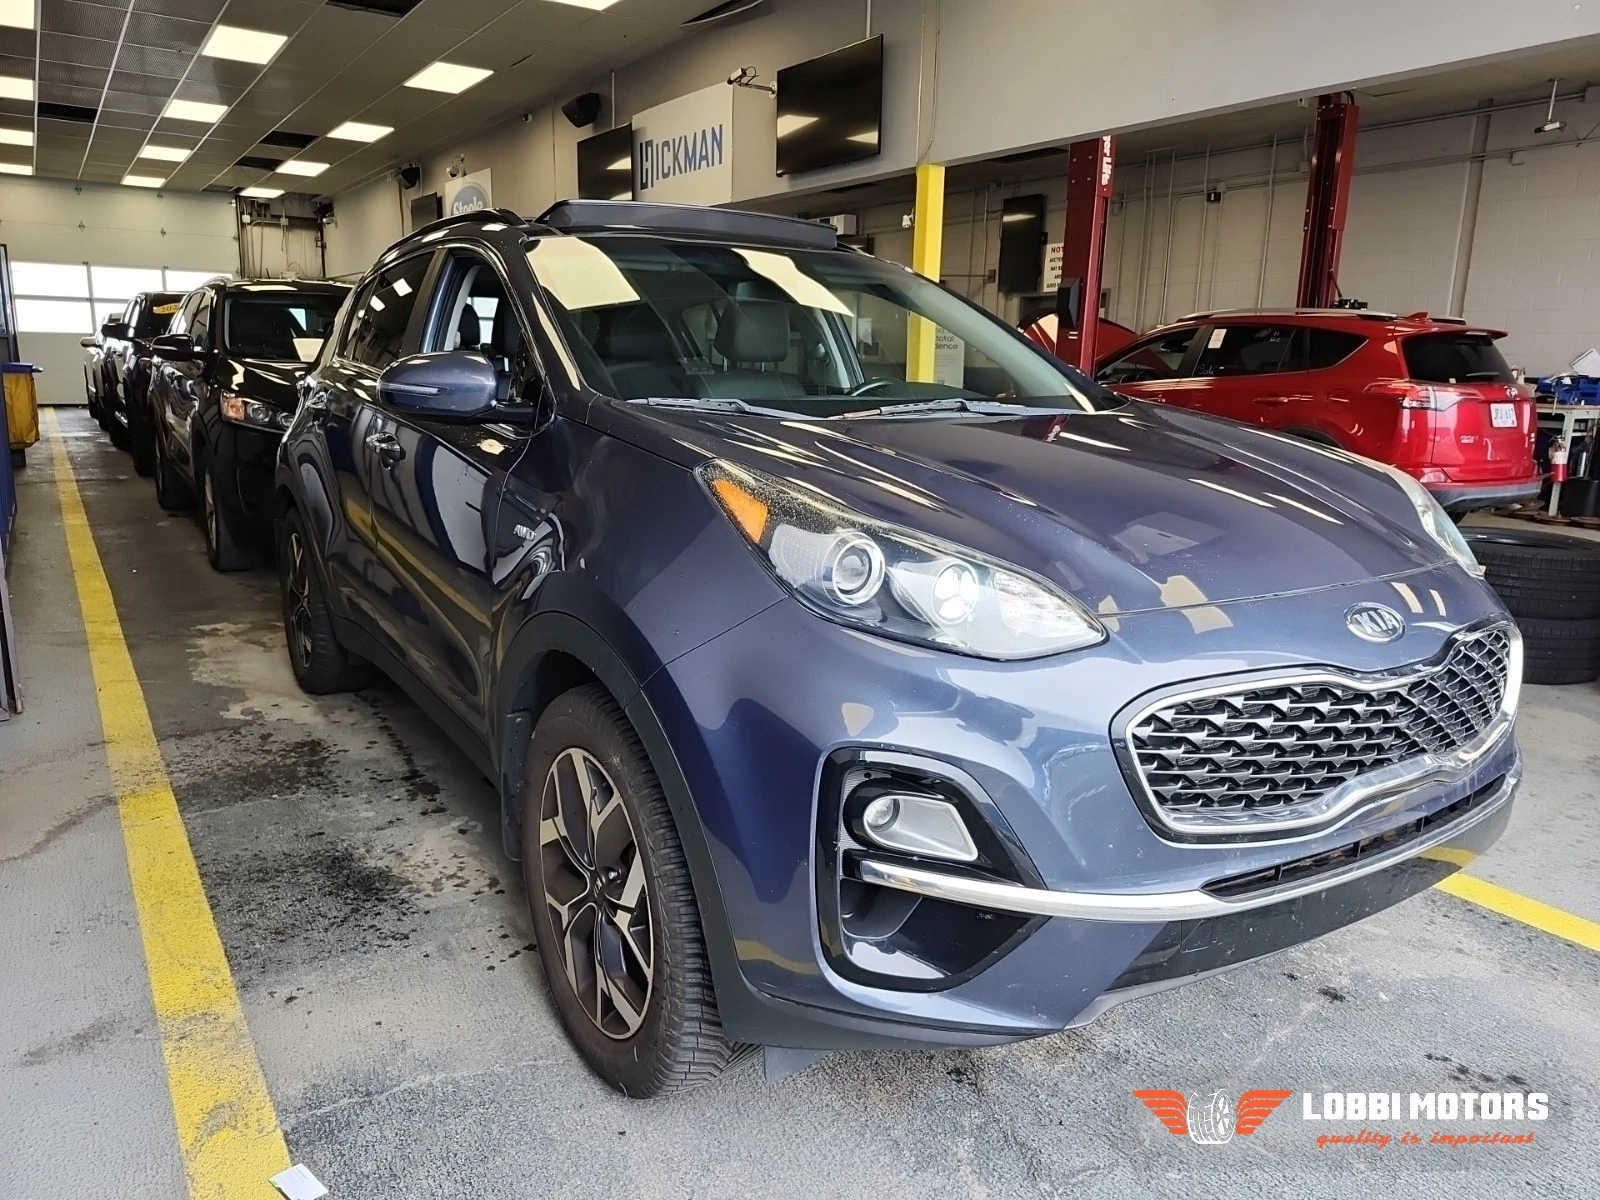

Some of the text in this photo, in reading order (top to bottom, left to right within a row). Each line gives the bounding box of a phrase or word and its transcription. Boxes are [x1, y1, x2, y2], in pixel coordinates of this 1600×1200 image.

[640, 124, 723, 190] HICKMAN
[513, 524, 537, 541] AWD
[1352, 610, 1400, 634] KIA
